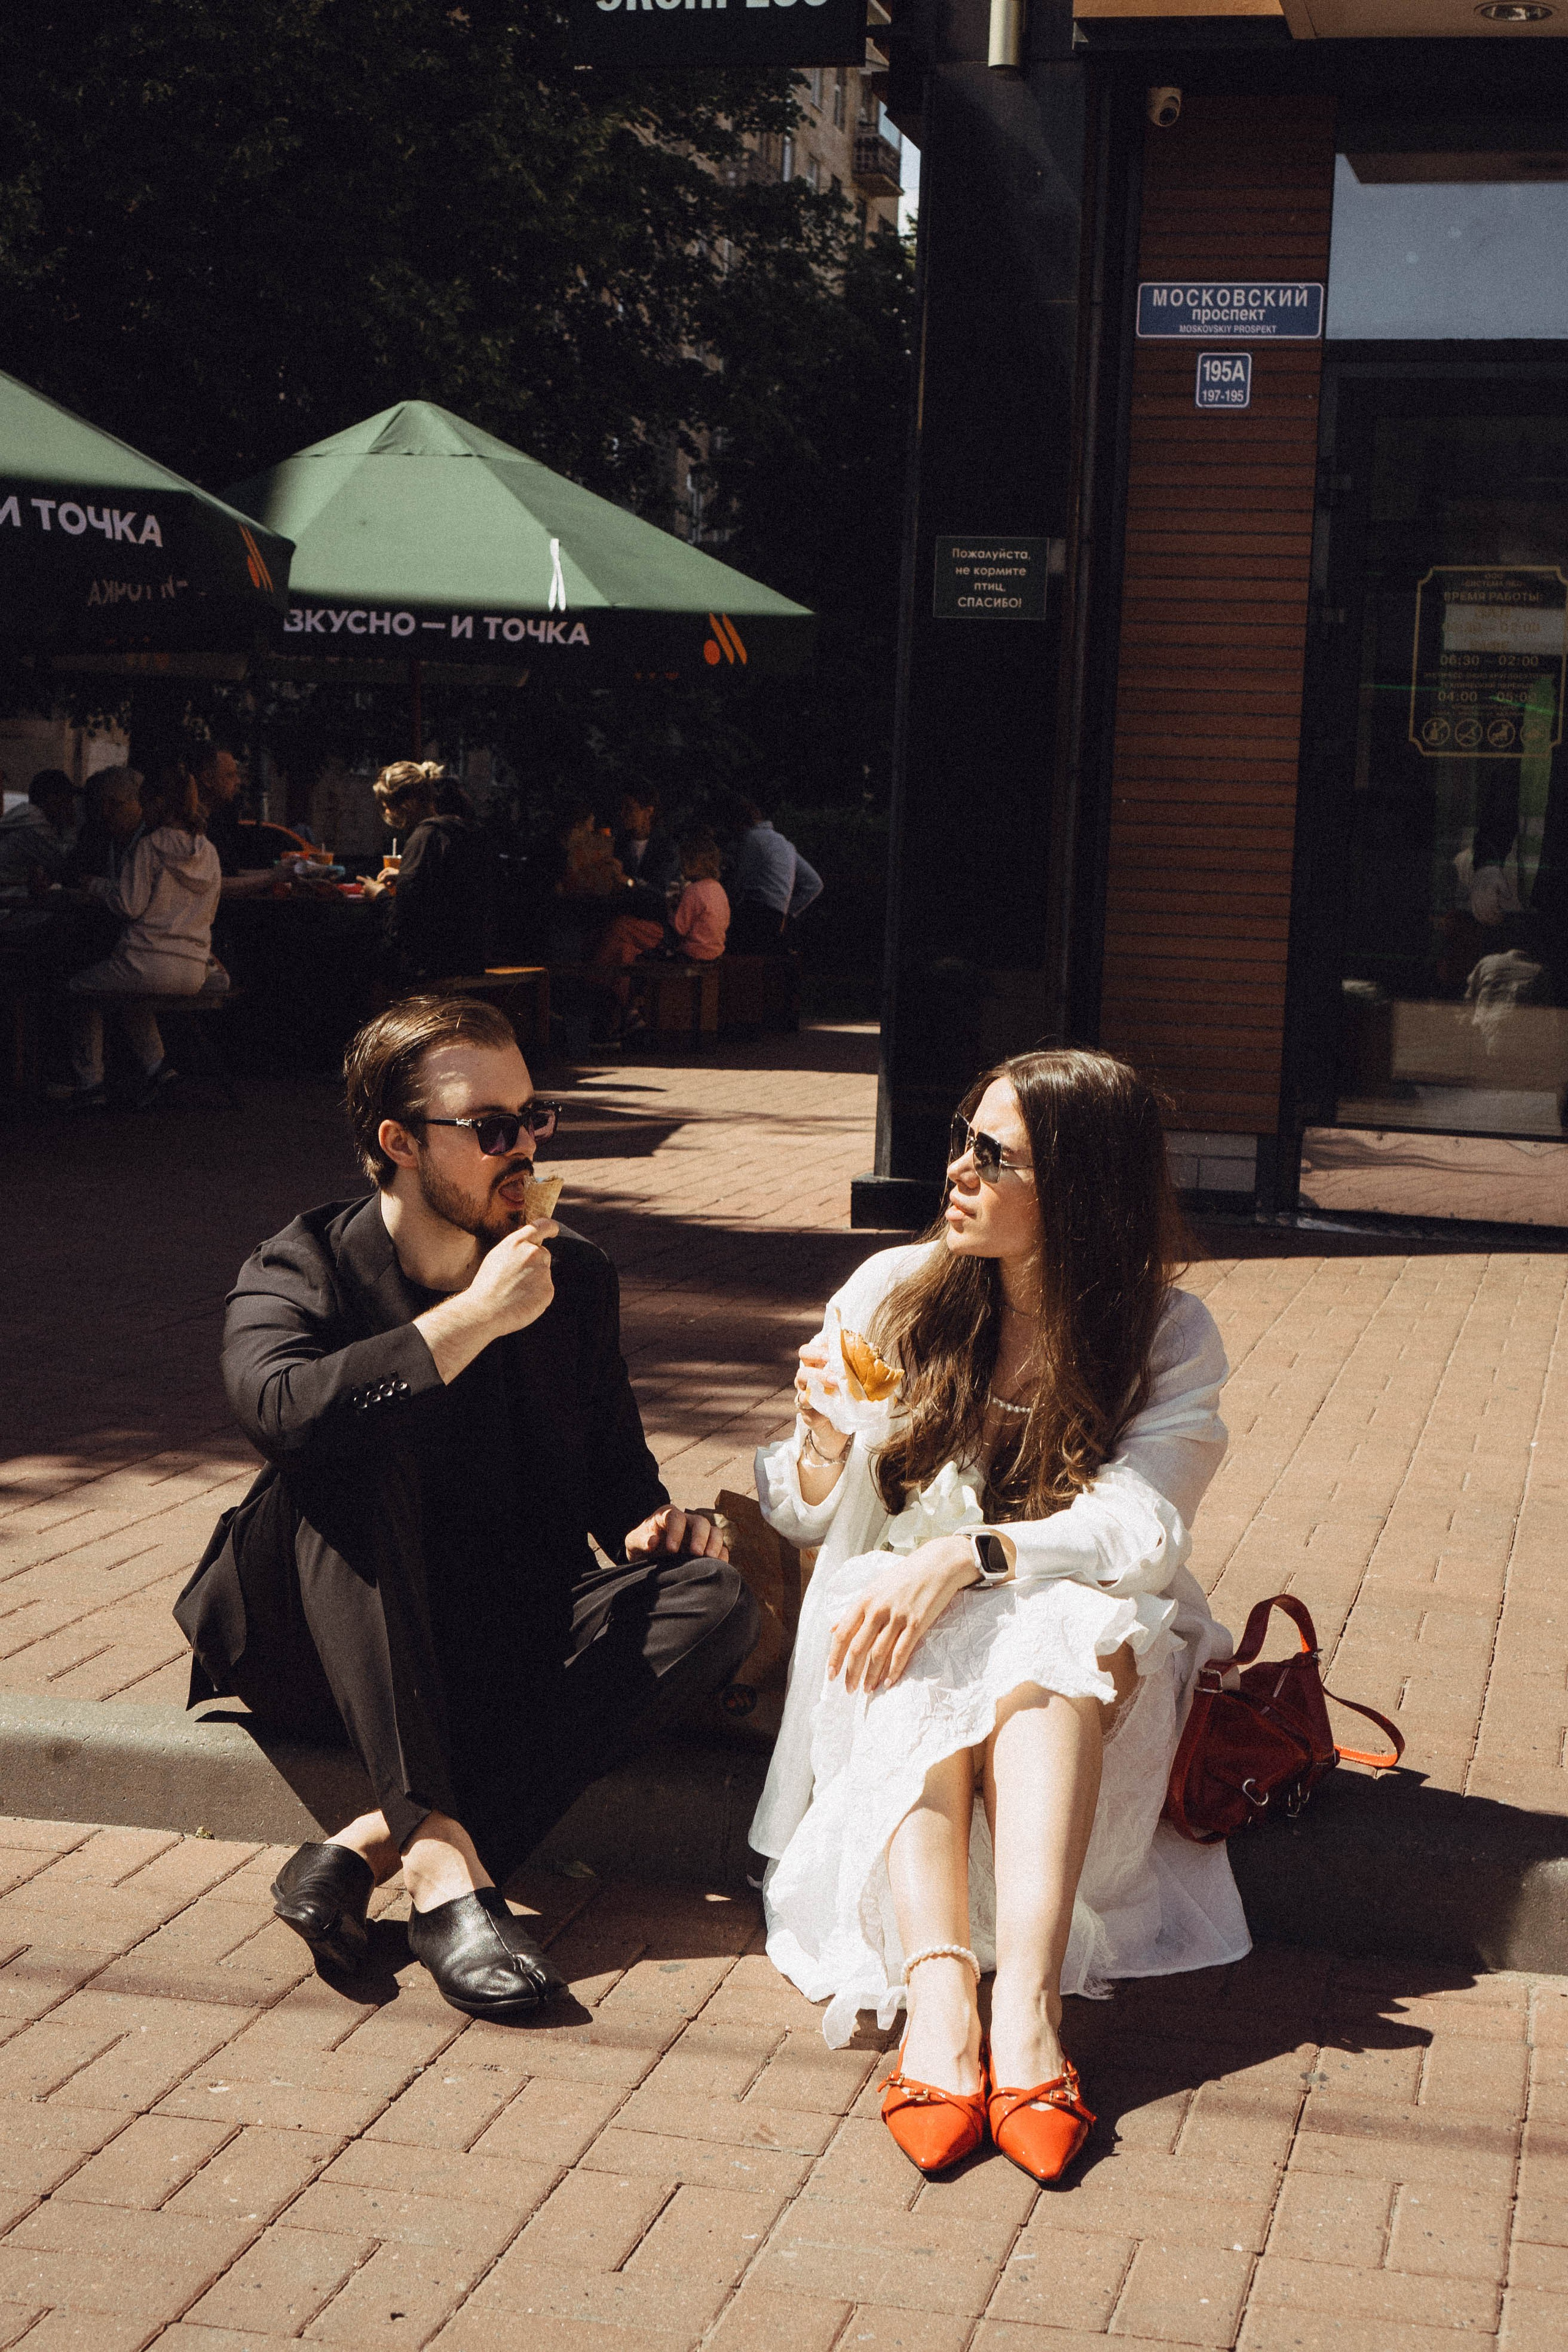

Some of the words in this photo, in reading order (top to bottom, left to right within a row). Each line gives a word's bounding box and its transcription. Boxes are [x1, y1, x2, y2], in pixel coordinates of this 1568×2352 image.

[1152, 285, 1308, 307] МОСКОВСКИЙ
[1192, 308, 1266, 324] проспект
[1179, 325, 1231, 333] MOSKOVSKIY
[1234, 325, 1277, 333] PROSPEKT
[1203, 360, 1245, 382] 195А
[1202, 389, 1244, 402] 197-195
[31, 498, 163, 548] ТОЧКА
[956, 567, 970, 575] не
[974, 567, 1027, 577] кормите
[958, 597, 1022, 608] СПАСИБО!
[1444, 592, 1486, 602] ВРЕМЯ
[284, 609, 416, 636] ВКУСНО
[451, 616, 473, 639] И
[483, 617, 590, 646] ТОЧКА
[1440, 654, 1480, 666] 06:30
[1498, 655, 1539, 667] 02:00
